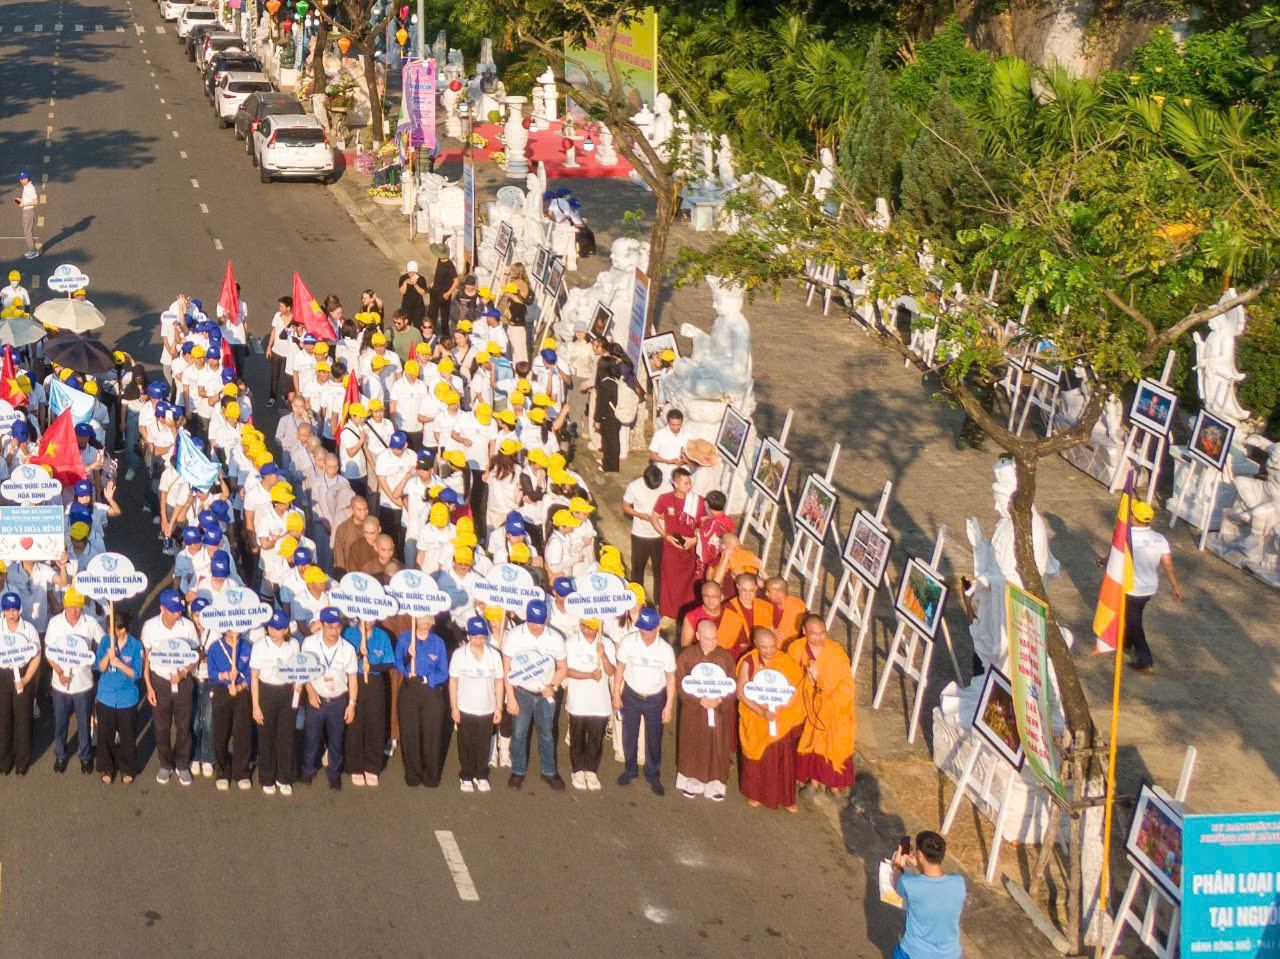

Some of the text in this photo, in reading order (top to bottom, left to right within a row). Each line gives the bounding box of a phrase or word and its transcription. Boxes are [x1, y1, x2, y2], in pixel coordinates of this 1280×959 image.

[123, 575, 142, 583] CHÂN
[426, 593, 446, 601] CHÂN
[520, 588, 540, 597] CHÂN
[612, 592, 632, 601] CHÂN
[374, 598, 392, 607] CHÂN
[248, 606, 268, 614] CHÂN
[1192, 869, 1235, 895] PHÂN
[1238, 872, 1273, 897] LOẠI
[1209, 906, 1233, 932] TẠI
